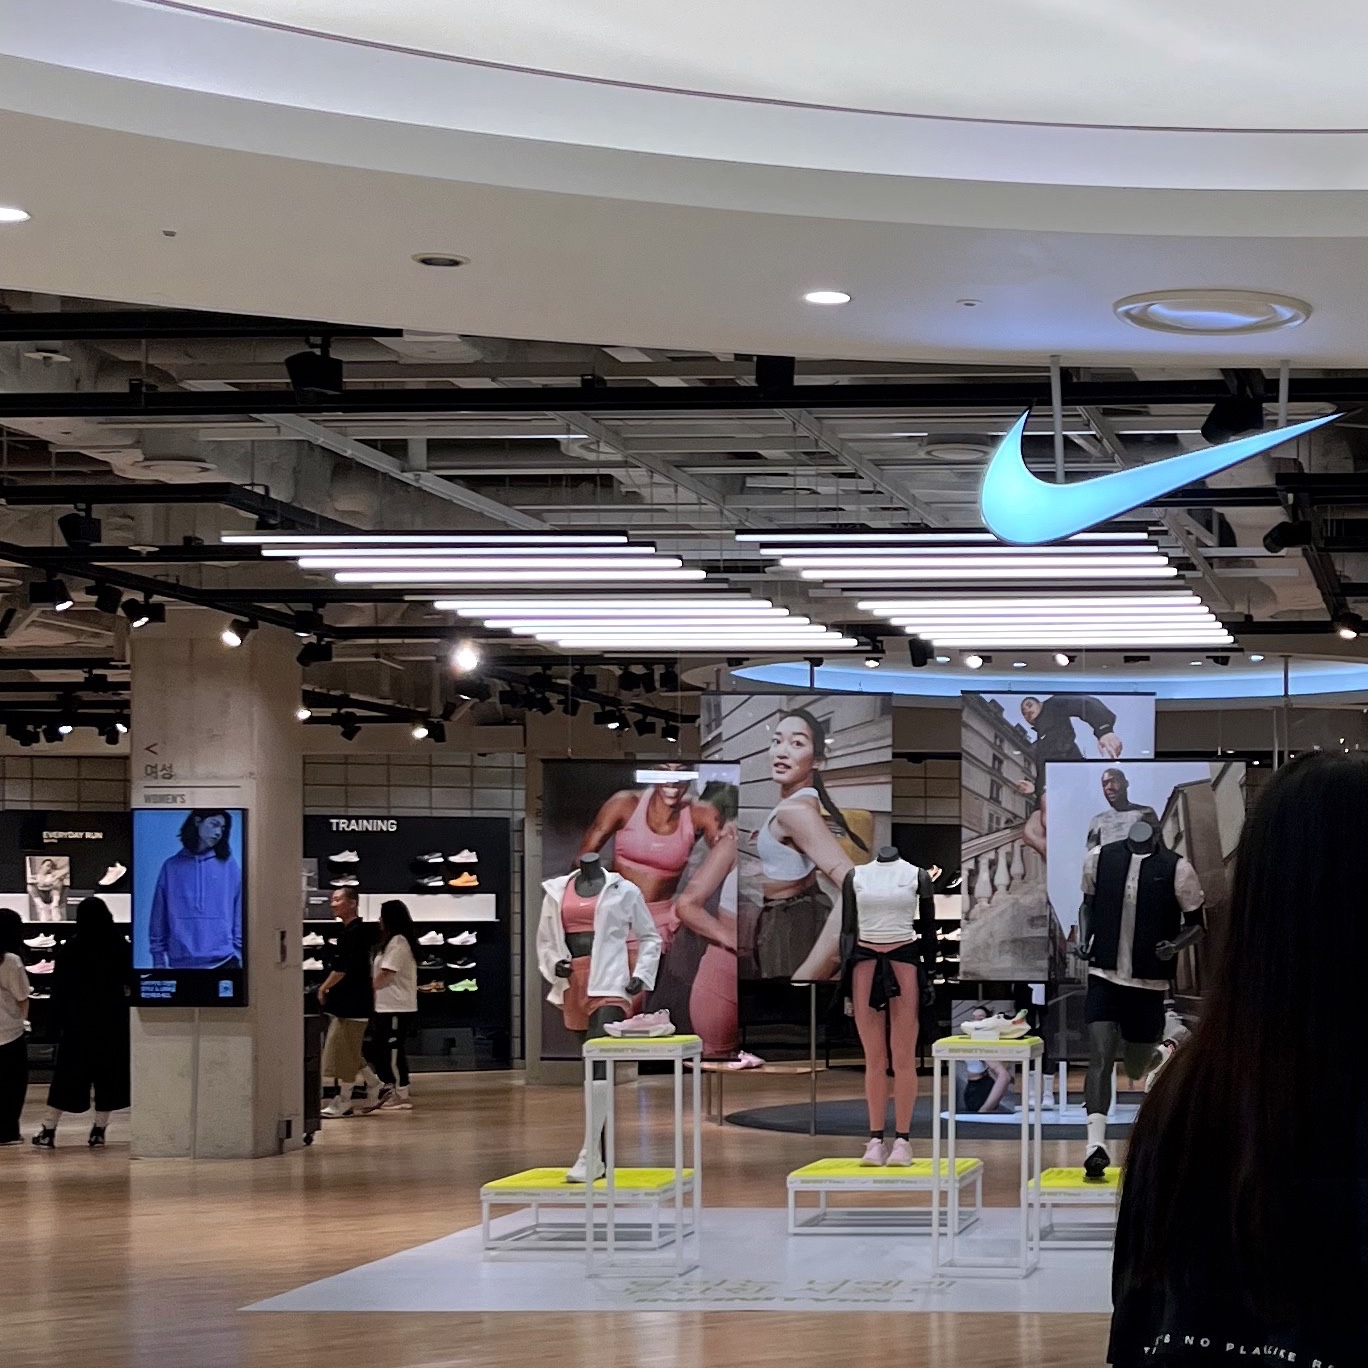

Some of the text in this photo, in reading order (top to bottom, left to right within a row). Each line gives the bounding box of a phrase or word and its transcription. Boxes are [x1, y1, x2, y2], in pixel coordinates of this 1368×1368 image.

[144, 763, 174, 780] 여성
[329, 818, 398, 832] TRAINING
[1184, 1335, 1211, 1348] NO
